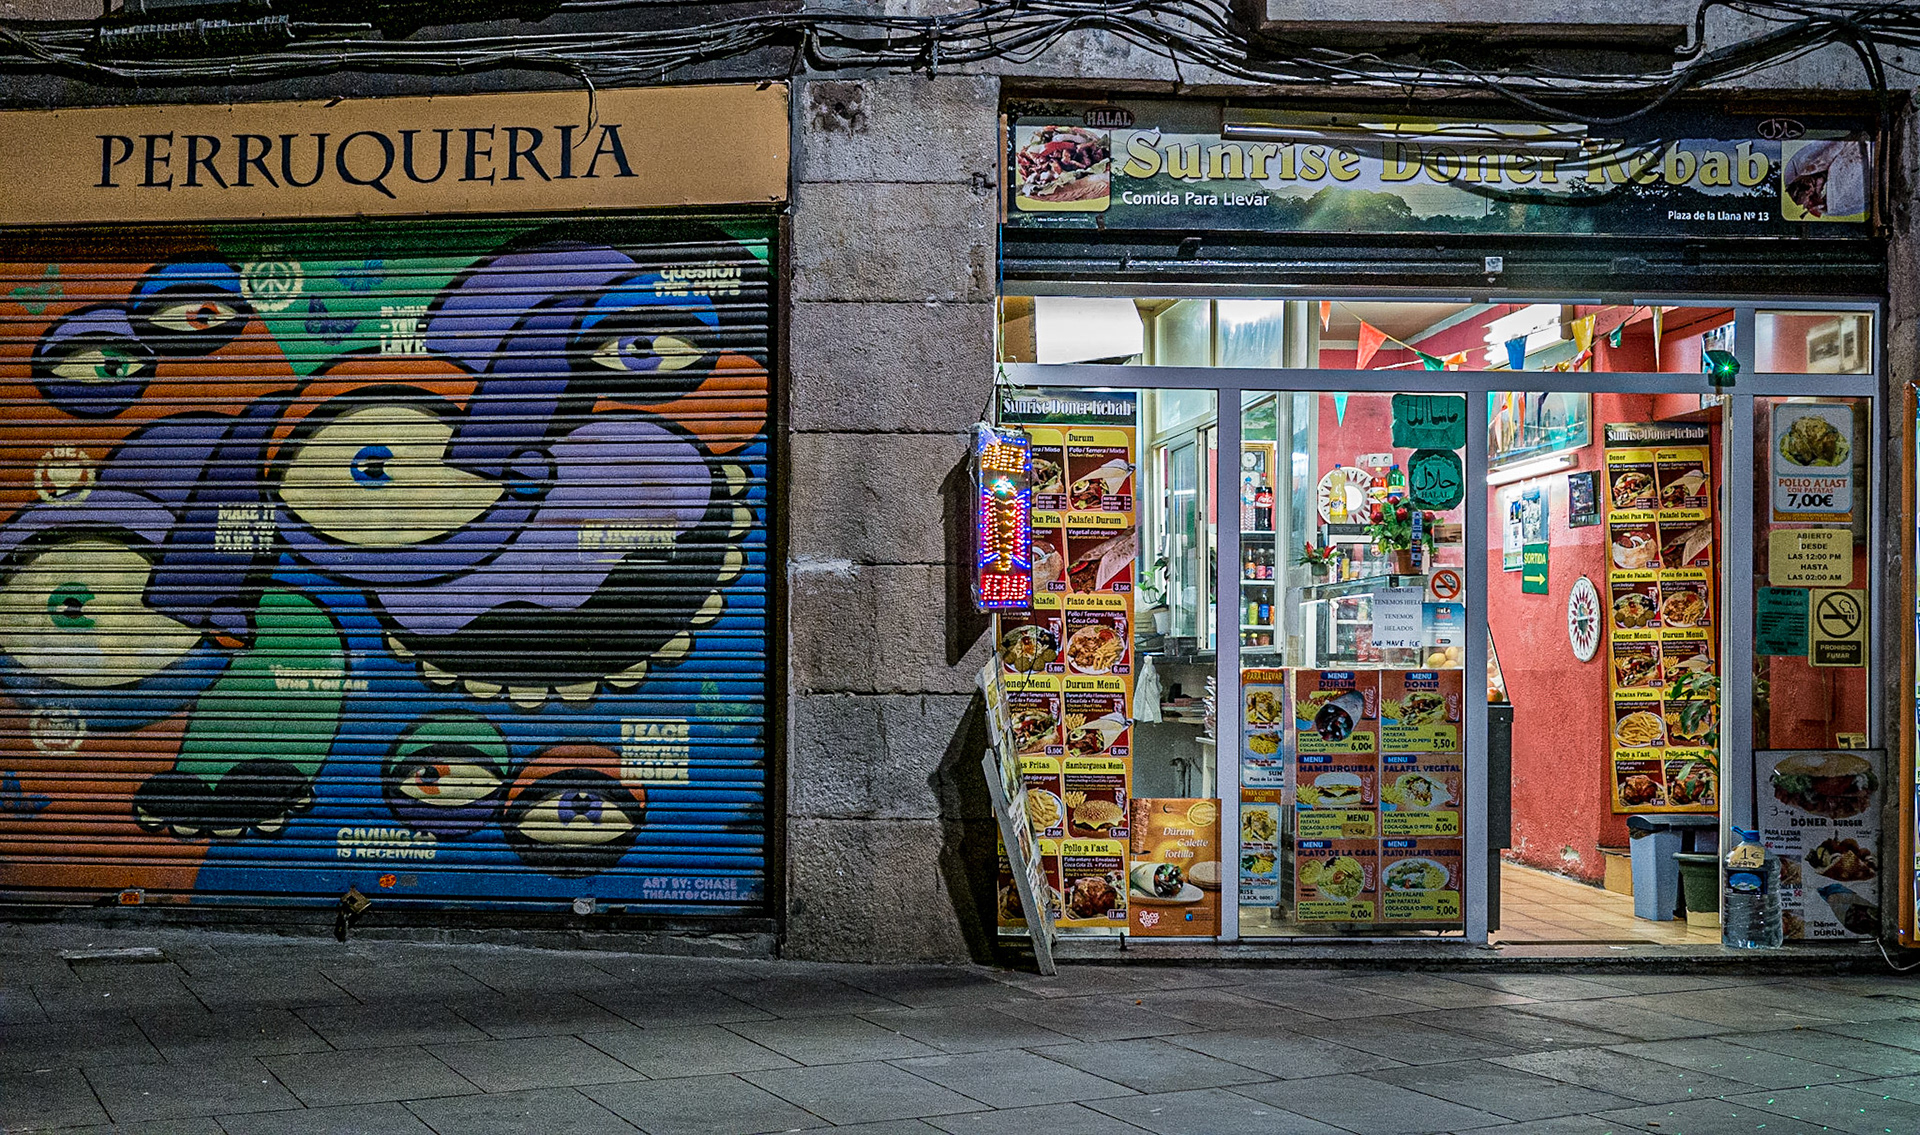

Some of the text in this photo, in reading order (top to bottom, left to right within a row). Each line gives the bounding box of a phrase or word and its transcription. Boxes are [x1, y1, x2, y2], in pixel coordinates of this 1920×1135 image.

[1087, 111, 1131, 126] HALAL
[1122, 127, 1360, 182] Sunrise
[1584, 139, 1770, 187] Kebab
[1122, 191, 1270, 207] Comida Para Llevar
[1668, 210, 1691, 220] Plaza
[1693, 211, 1705, 220] de
[1707, 211, 1715, 220] la
[1717, 211, 1741, 221] Llana
[1758, 212, 1769, 221] 13
[660, 260, 741, 282] question
[1004, 398, 1131, 416] Sunrise Doner Kebab
[1069, 433, 1094, 442] Durum
[1778, 478, 1811, 487] POLLO
[1787, 494, 1834, 509] 7,00€
[1046, 515, 1061, 524] Pita
[1068, 516, 1121, 524] Falafel Durum
[1523, 552, 1547, 564] SORTIDA
[1770, 588, 1803, 596] OFERTA
[1067, 598, 1085, 606] Plato
[1087, 598, 1096, 606] de
[1246, 672, 1283, 681] PARA LLEVAR
[1327, 672, 1348, 680] MENU
[1027, 679, 1051, 689] Menú
[1066, 680, 1120, 690] Durum Menú
[621, 723, 690, 741] PEACE
[1028, 762, 1050, 770] Fritas
[1347, 814, 1370, 822] MENU
[1833, 819, 1863, 827] BURGER
[337, 827, 411, 847] GIVING
[1064, 843, 1082, 851] Pollo
[337, 847, 437, 860] IS RECEIVING
[1165, 849, 1194, 859] Tortilla
[1741, 847, 1748, 860] 1
[643, 877, 668, 889] ART
[694, 878, 738, 890] CHASE
